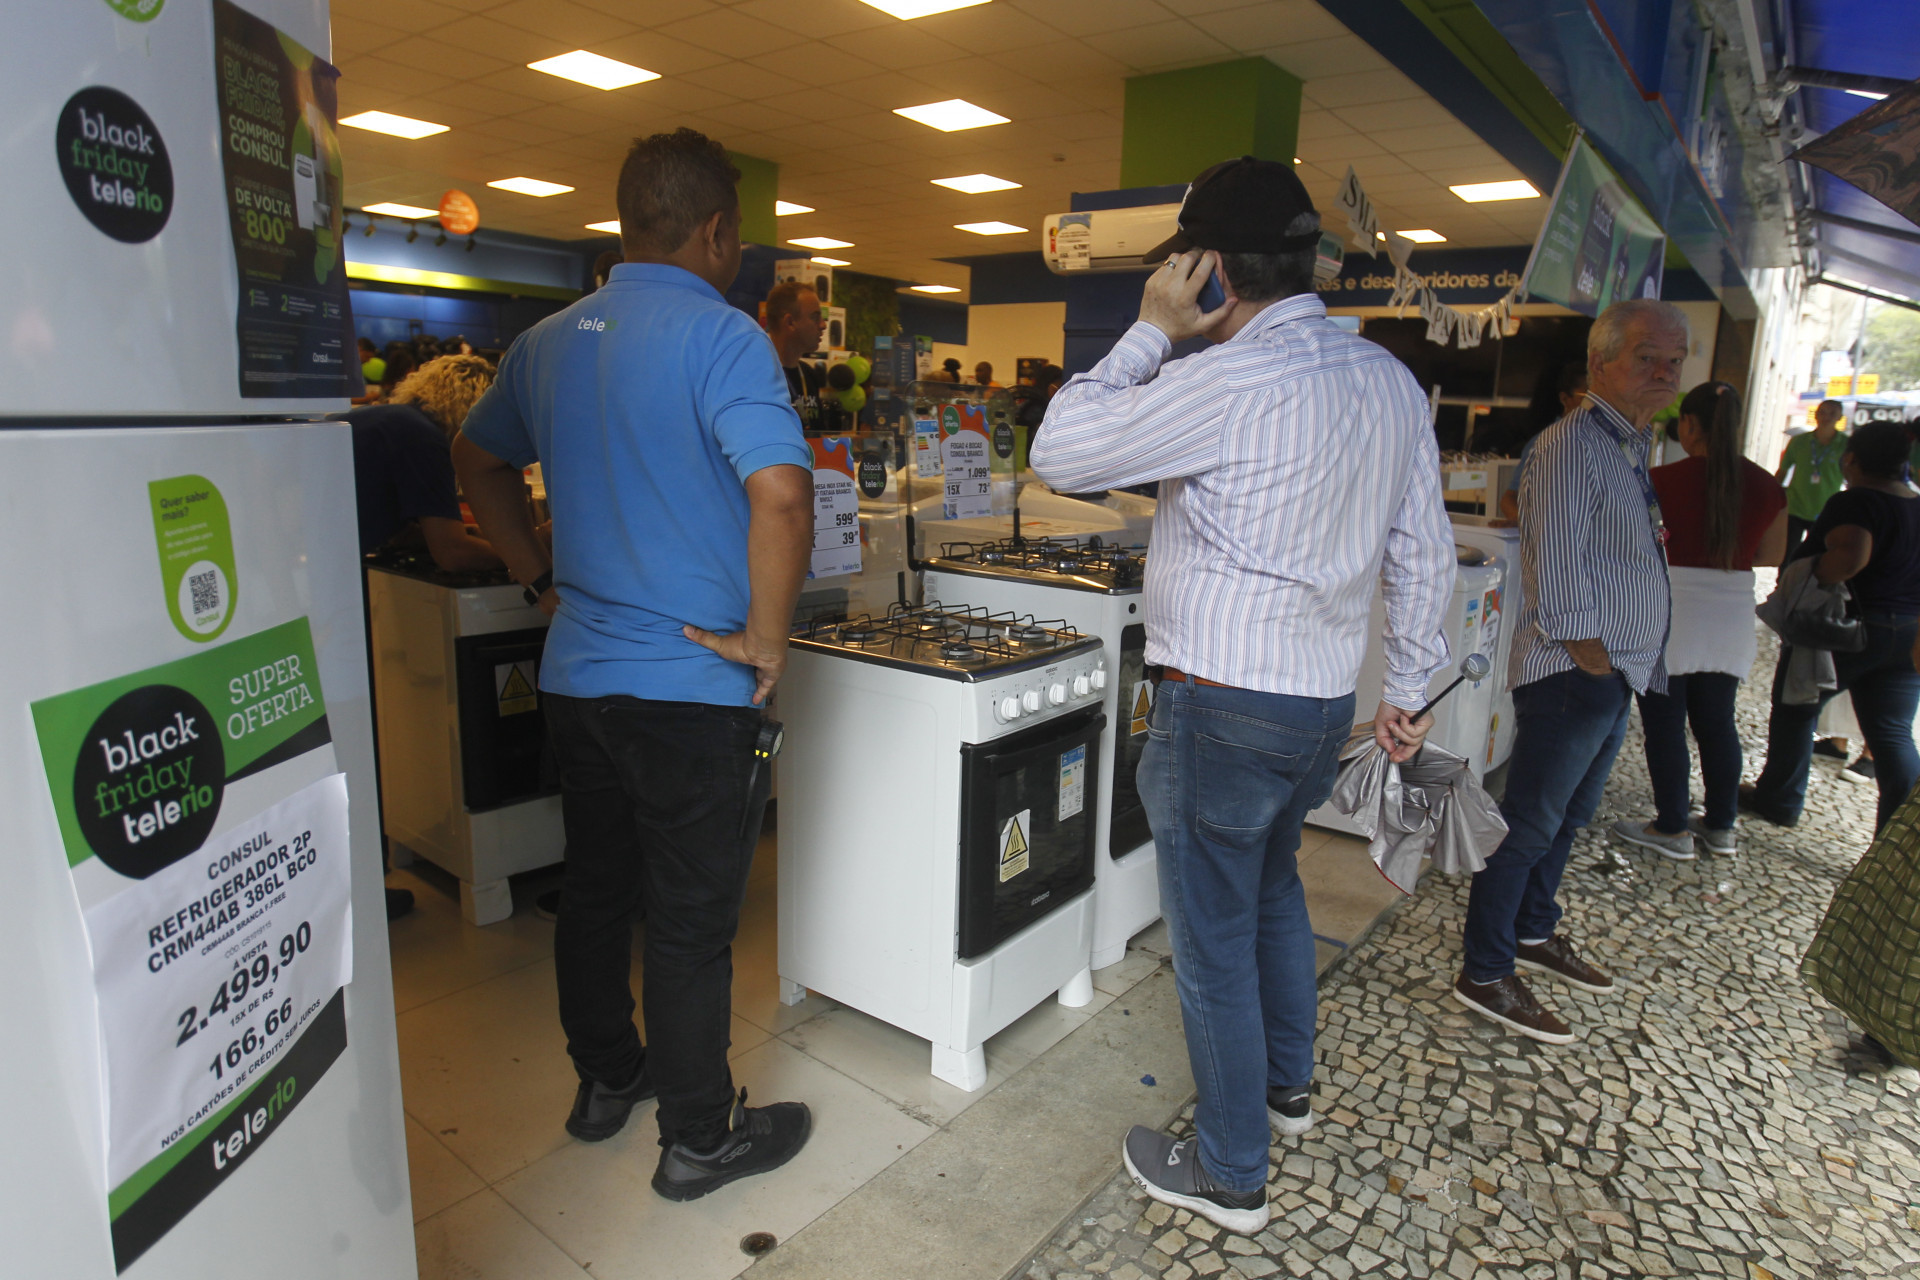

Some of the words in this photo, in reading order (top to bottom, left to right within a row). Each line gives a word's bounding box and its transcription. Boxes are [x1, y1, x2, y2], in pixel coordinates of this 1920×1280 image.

[224, 55, 281, 104] BLACK
[80, 107, 154, 155] black
[229, 114, 285, 149] COMPROU
[71, 138, 149, 186] friday
[91, 174, 163, 212] telerio
[235, 187, 252, 207] DE
[863, 463, 882, 471] black
[865, 480, 884, 488] telerio
[947, 484, 960, 495] 15X
[228, 654, 303, 705] SUPER
[227, 683, 314, 739] OFERTA
[99, 712, 199, 773] black
[94, 756, 194, 818] friday
[123, 784, 214, 844] telerio
[207, 831, 272, 880] CONSUL
[148, 844, 290, 948] REFRIGERADOR
[293, 830, 312, 854] 2P
[148, 900, 240, 973] CRM44AB
[244, 873, 284, 909] 386L
[287, 848, 317, 880] BCO
[236, 908, 264, 931] BRANCA
[265, 891, 287, 912] F.FREE
[242, 940, 268, 963] VISTA
[176, 920, 311, 1048] 2.499,90
[230, 1012, 246, 1027] 15X
[248, 998, 260, 1013] DE
[209, 997, 292, 1080] 166,66
[161, 1125, 185, 1149] NOS
[187, 1084, 234, 1127] CARTÕES
[236, 1072, 247, 1087] DE
[248, 1038, 284, 1074] CRÉDITO
[285, 1025, 298, 1041] SEM
[298, 998, 321, 1025] JUROS
[212, 1076, 296, 1171] telerio
[1168, 1141, 1186, 1166] ILA
[1133, 1176, 1147, 1190] FILA
